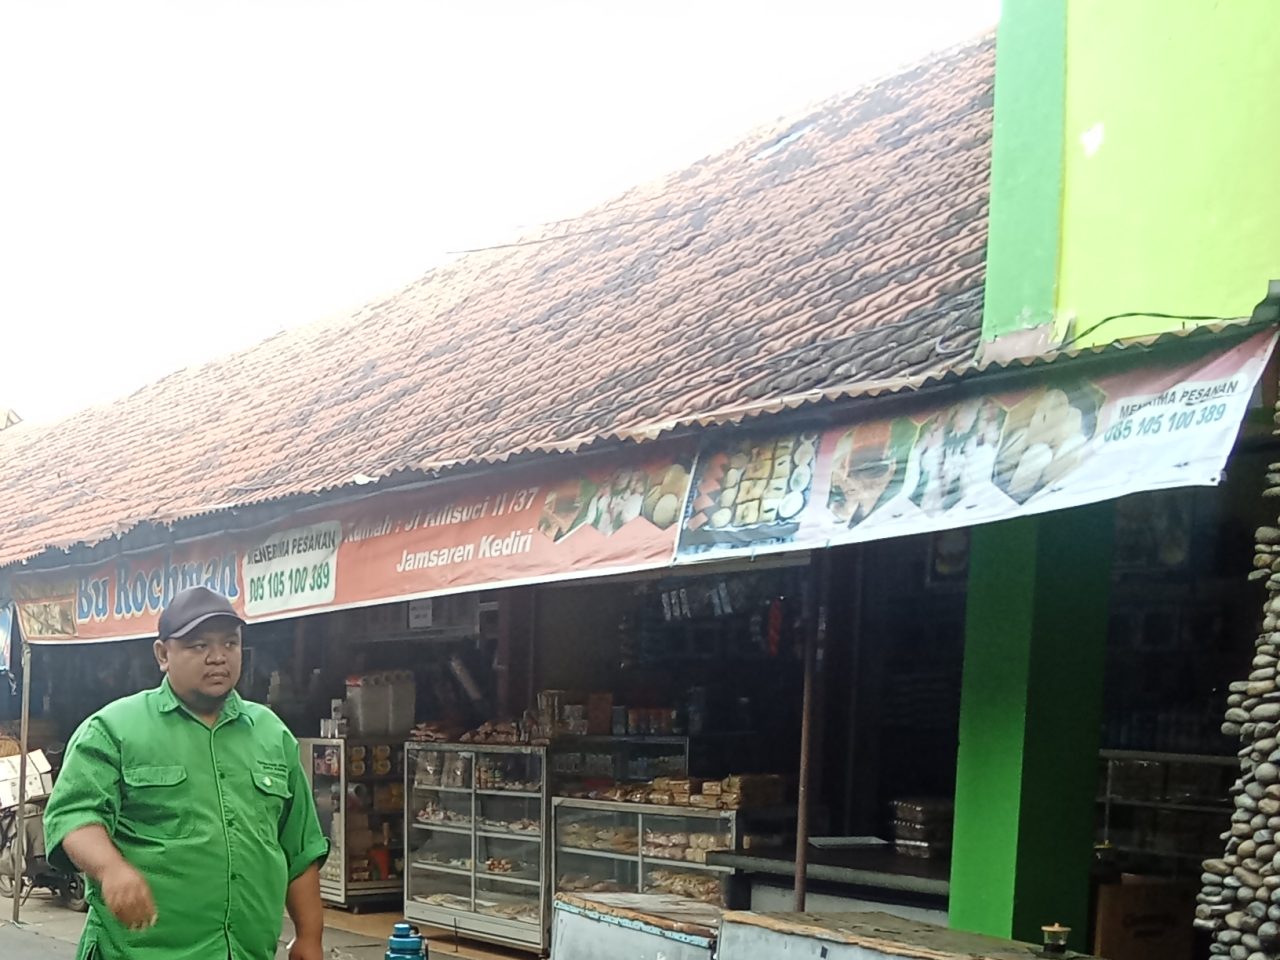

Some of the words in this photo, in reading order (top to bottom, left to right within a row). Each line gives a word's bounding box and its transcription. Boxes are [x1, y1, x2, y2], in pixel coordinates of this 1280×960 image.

[1179, 380, 1239, 404] PESANAN
[1136, 413, 1165, 436] 105
[1168, 409, 1196, 432] 100
[1196, 403, 1227, 425] 389
[291, 530, 336, 555] PESANAN
[396, 543, 473, 572] Jamsaren
[478, 528, 534, 559] Kediri
[77, 575, 108, 620] Bu
[115, 553, 239, 616] Rochman
[268, 571, 285, 598] 105
[288, 566, 308, 596] 100
[309, 562, 330, 591] 389
